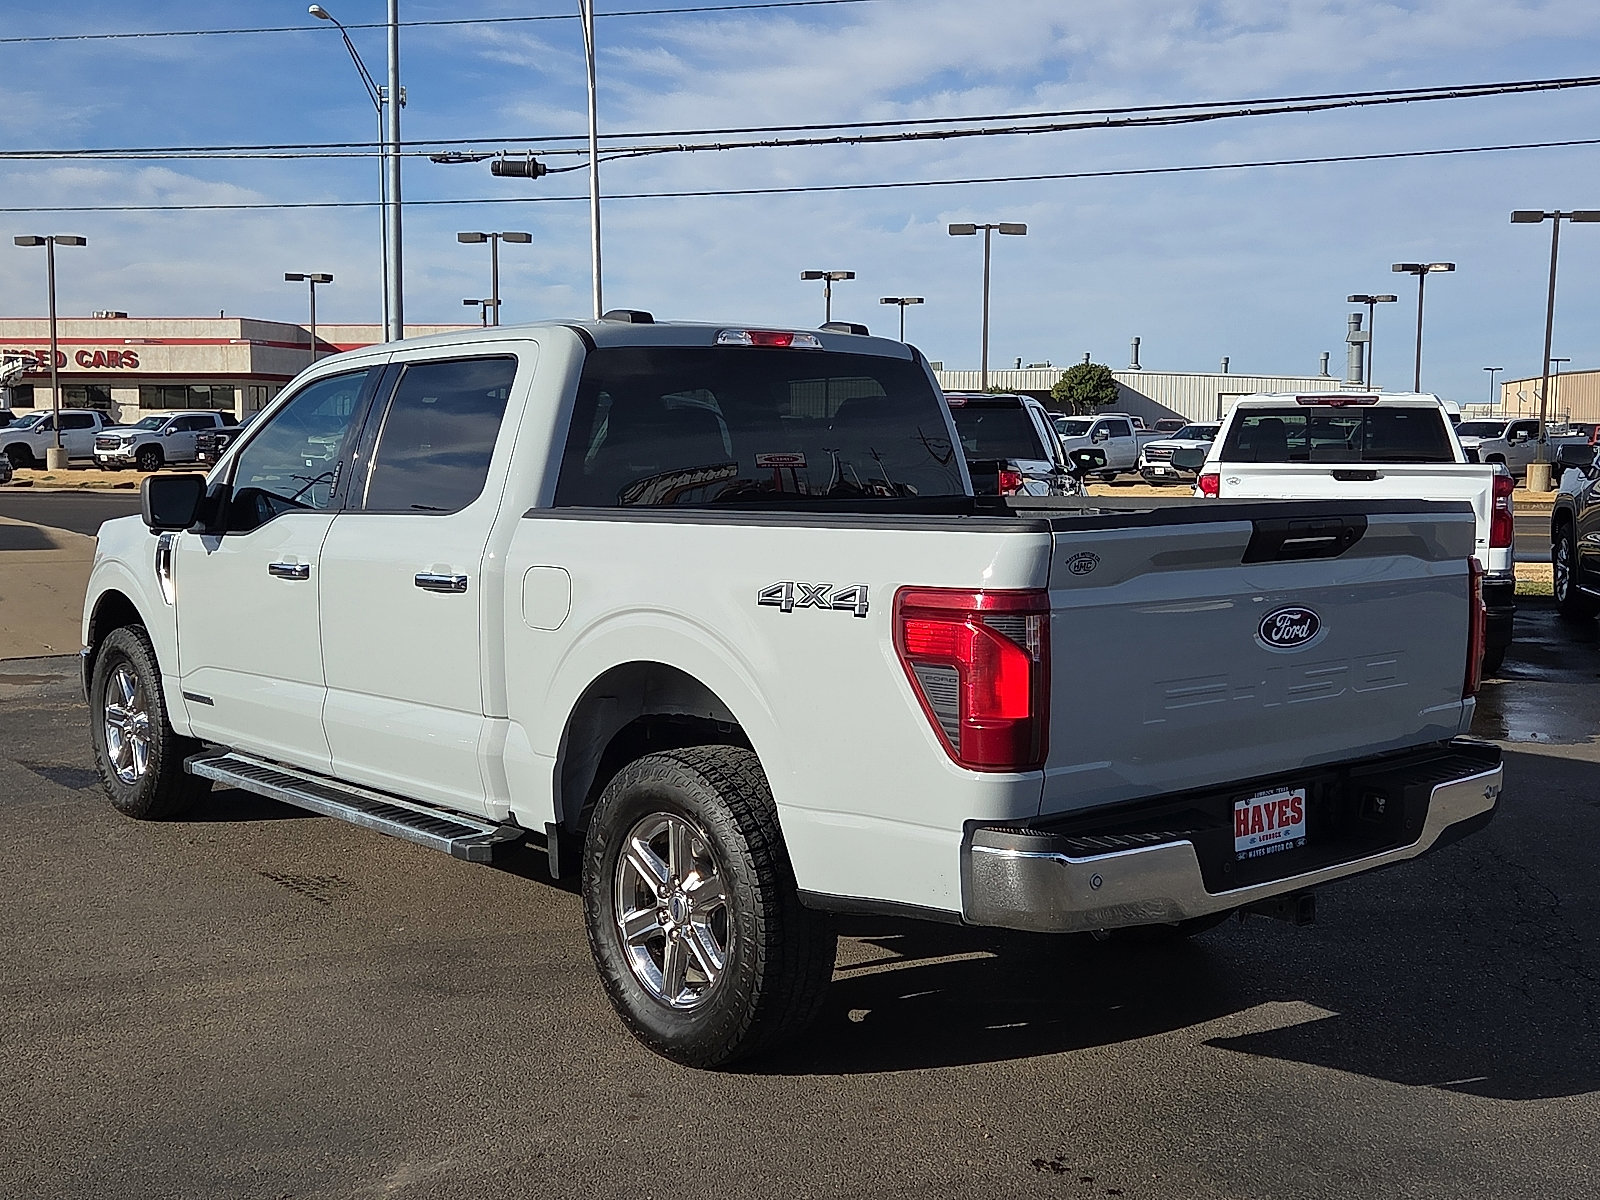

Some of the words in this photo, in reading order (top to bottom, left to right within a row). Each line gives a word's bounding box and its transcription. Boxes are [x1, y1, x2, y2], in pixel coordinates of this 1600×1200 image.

[75, 349, 140, 369] CARS
[1271, 613, 1310, 640] Ford
[925, 675, 957, 683] FORD
[1235, 796, 1303, 838] HAYES
[1248, 848, 1266, 859] HAYES
